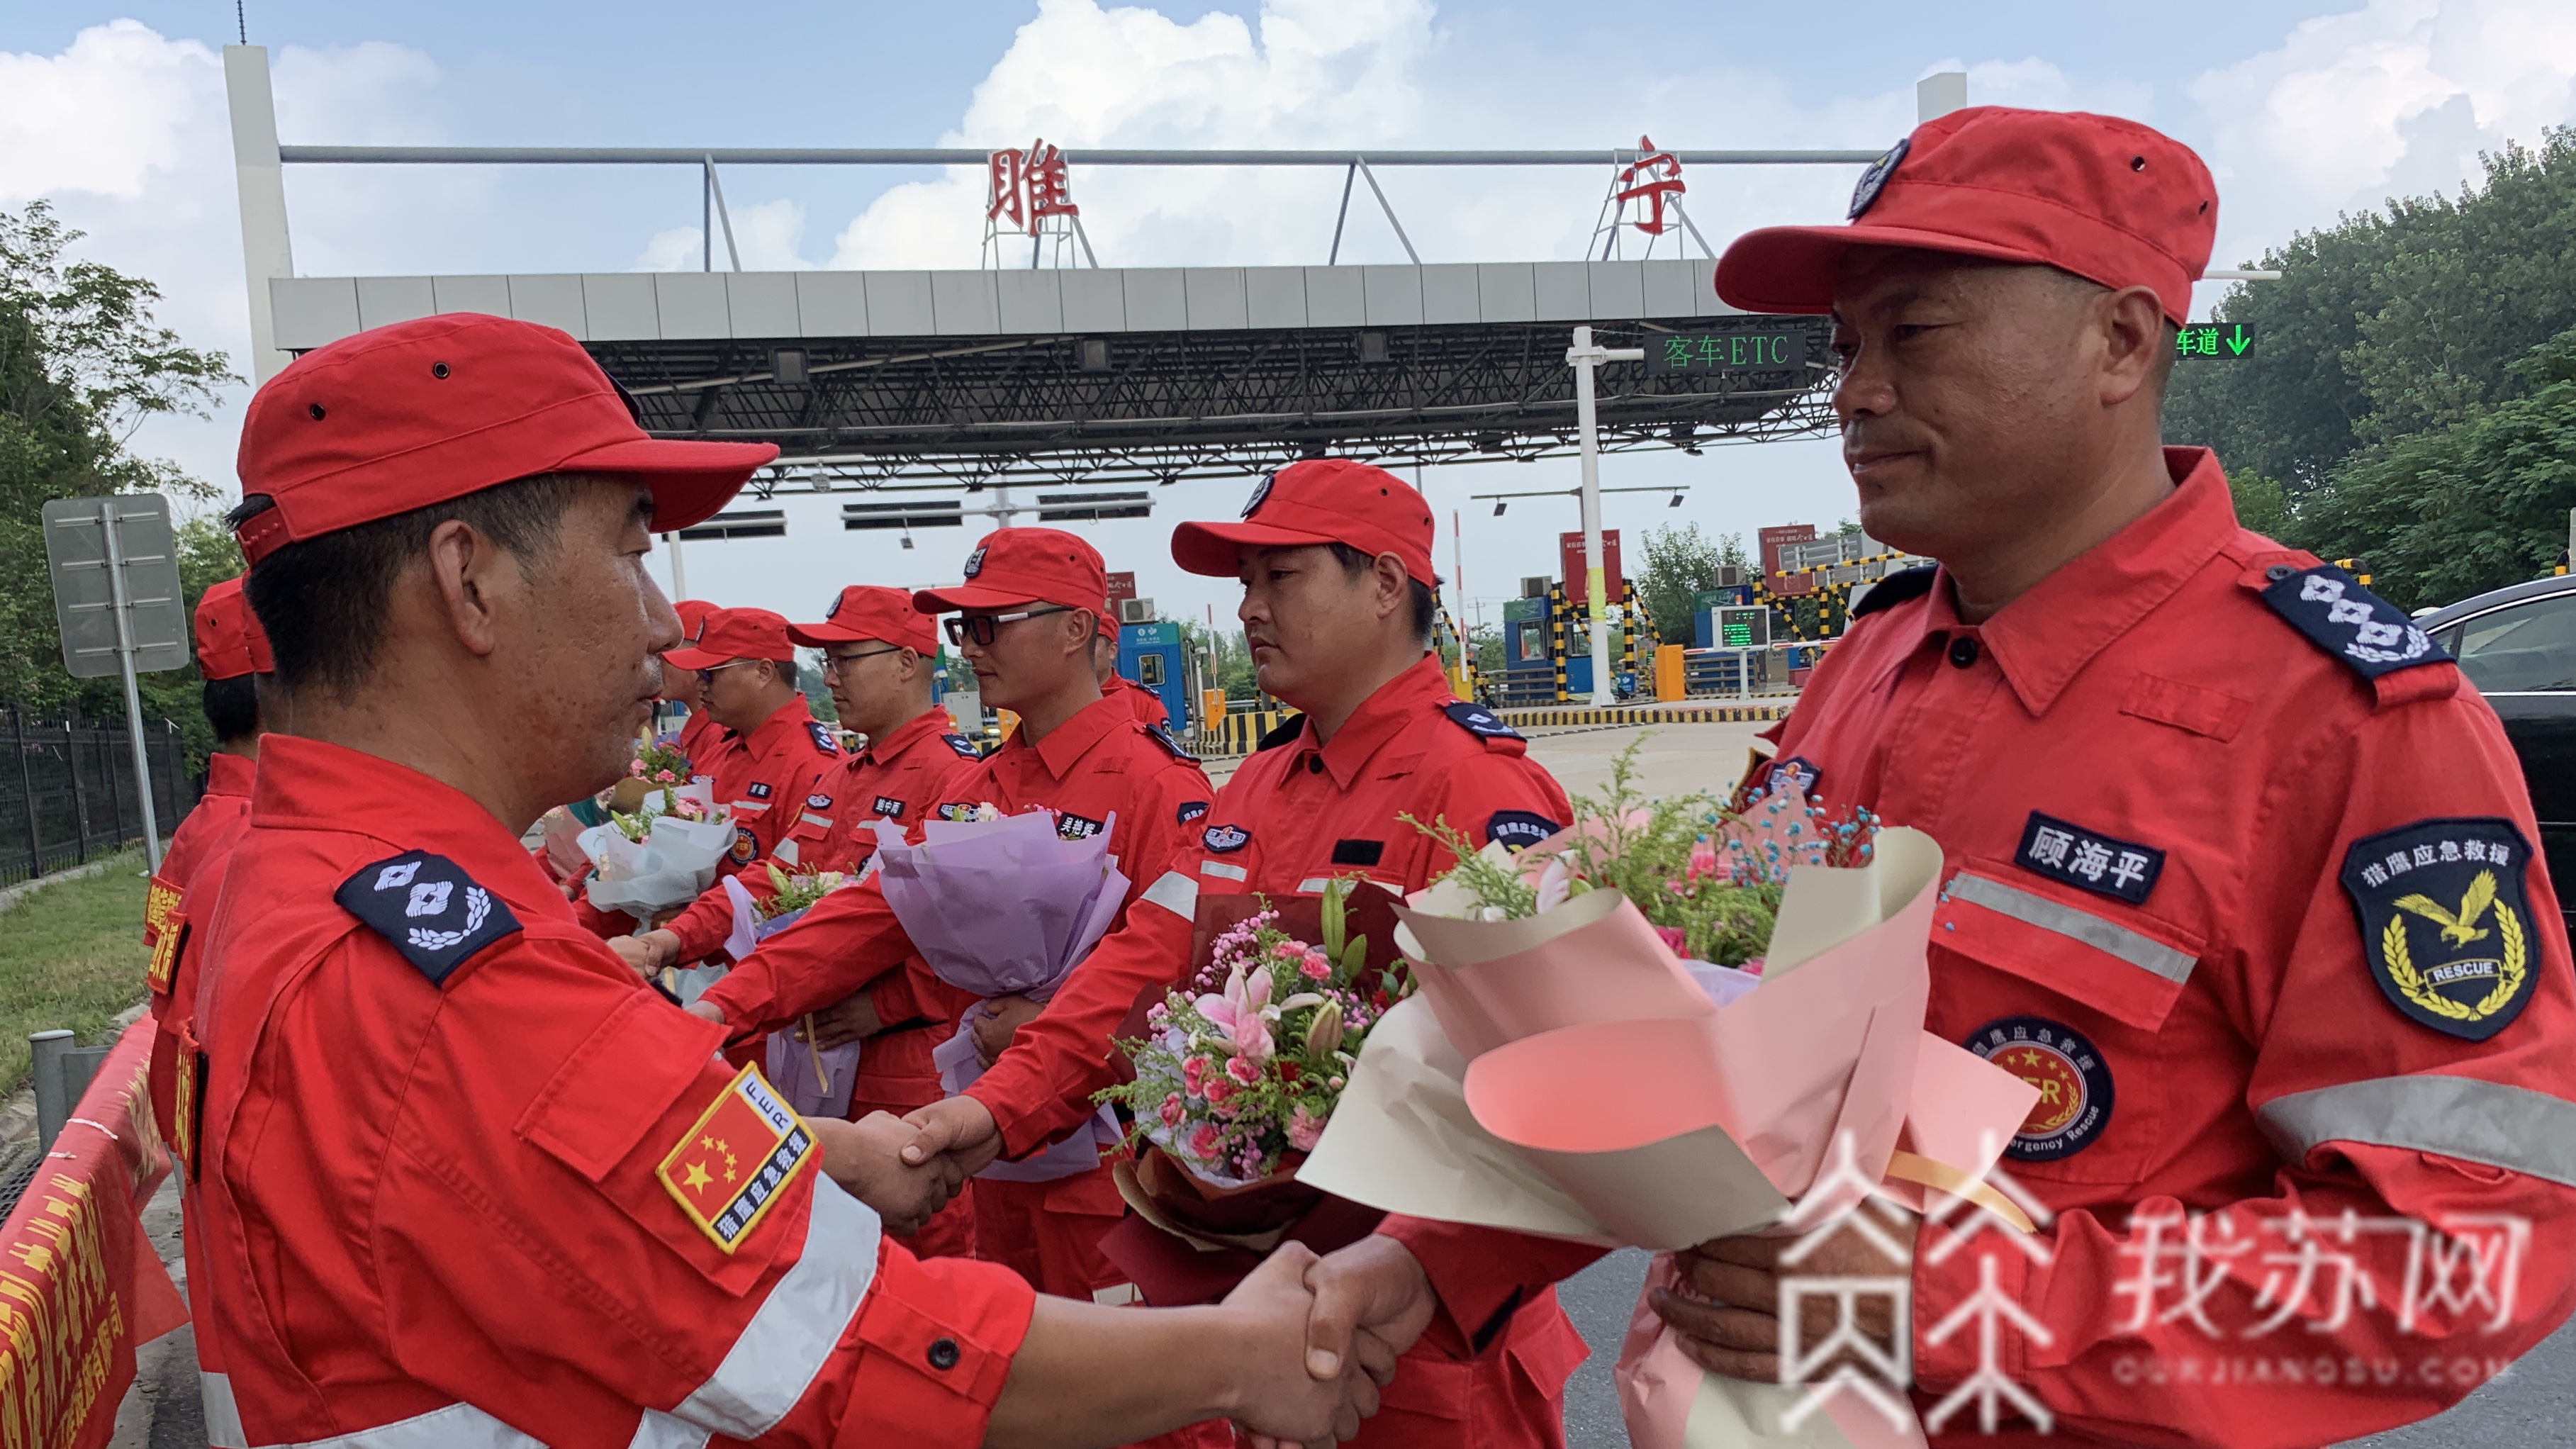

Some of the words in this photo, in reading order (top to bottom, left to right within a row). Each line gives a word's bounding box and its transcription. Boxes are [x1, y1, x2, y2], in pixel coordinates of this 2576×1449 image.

[1664, 335, 1788, 369] 客车ETC
[2176, 328, 2219, 355] 车道
[2028, 825, 2149, 889] 顾海平
[2361, 839, 2510, 888] 猎鹰应急救援
[2433, 962, 2493, 982] RESCUE
[745, 1080, 788, 1129] FER
[2066, 1105, 2100, 1141] Rescue
[717, 1130, 807, 1239] 猎鹰应急救援
